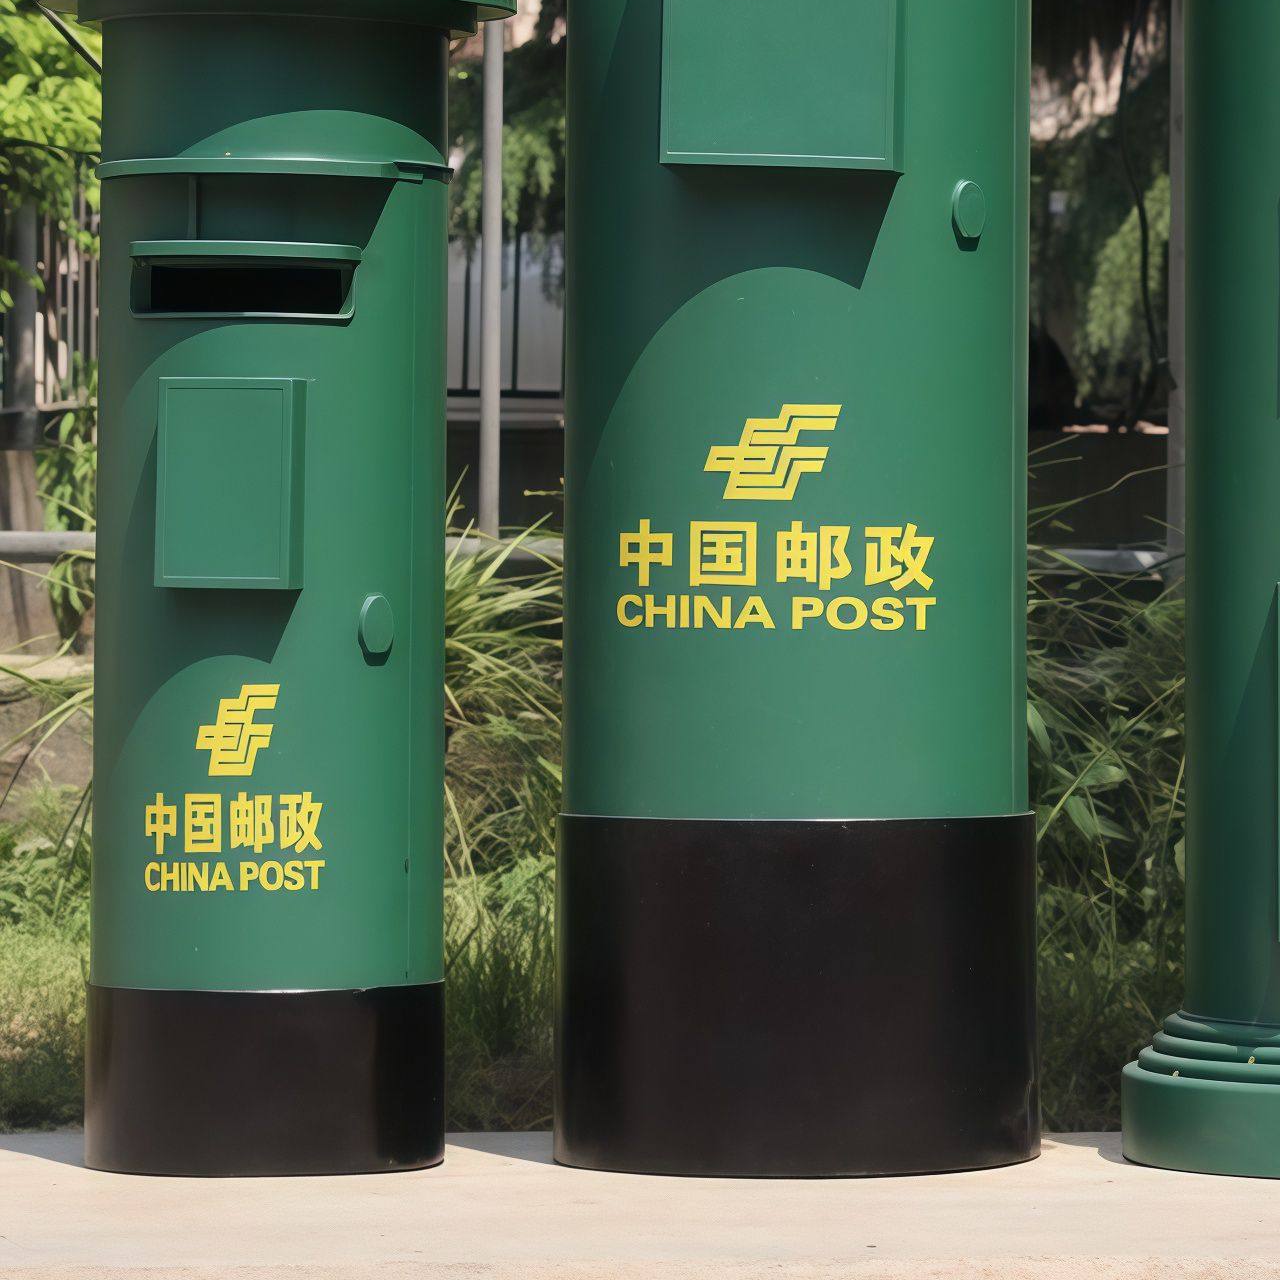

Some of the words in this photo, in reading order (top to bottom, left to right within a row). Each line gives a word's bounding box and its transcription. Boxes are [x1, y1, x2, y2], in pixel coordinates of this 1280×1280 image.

[619, 518, 934, 591] 中国邮政
[616, 594, 776, 631] CHINA
[791, 595, 937, 631] POST
[144, 791, 323, 855] 中国邮政
[144, 861, 234, 892] CHINA
[239, 860, 326, 891] POST
